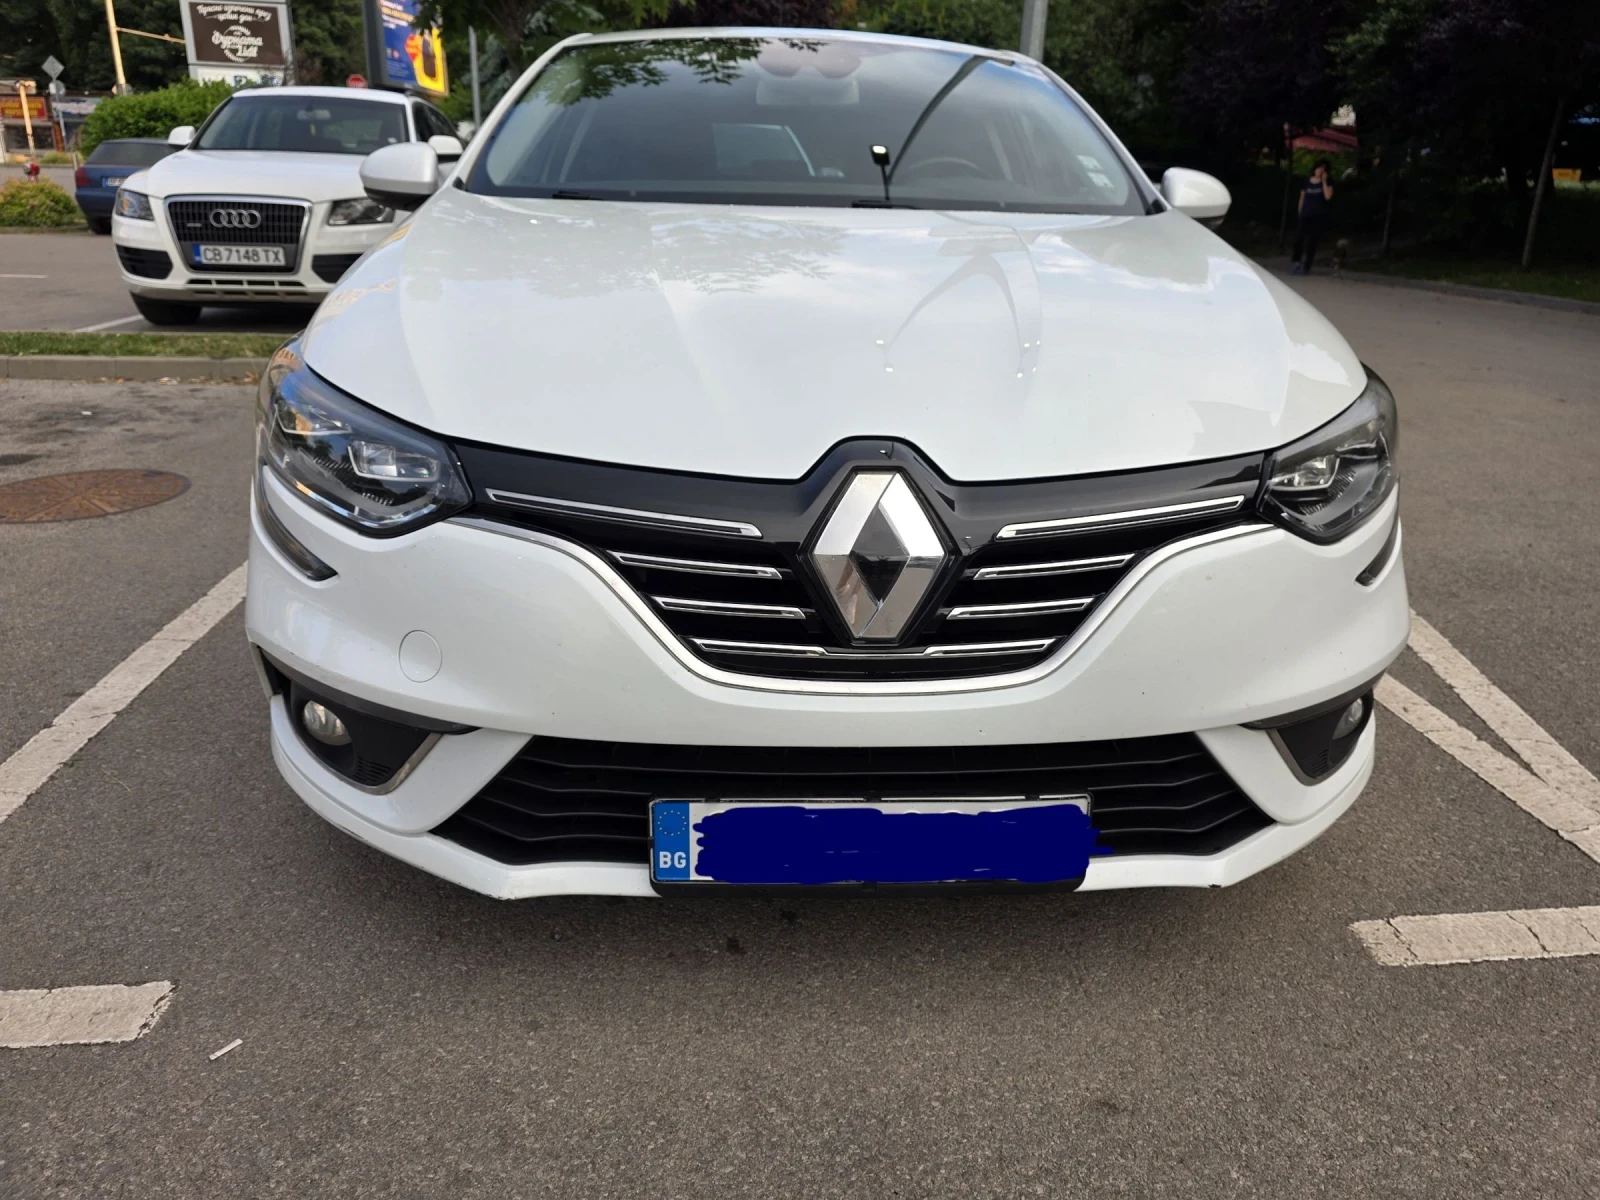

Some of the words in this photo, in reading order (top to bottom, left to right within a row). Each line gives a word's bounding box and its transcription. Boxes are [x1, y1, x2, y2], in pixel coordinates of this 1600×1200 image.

[211, 30, 263, 49] Фурната
[236, 44, 258, 57] Lidl
[203, 247, 222, 262] CB
[224, 248, 260, 262] 7148
[262, 249, 282, 263] TX
[659, 851, 687, 869] BG
